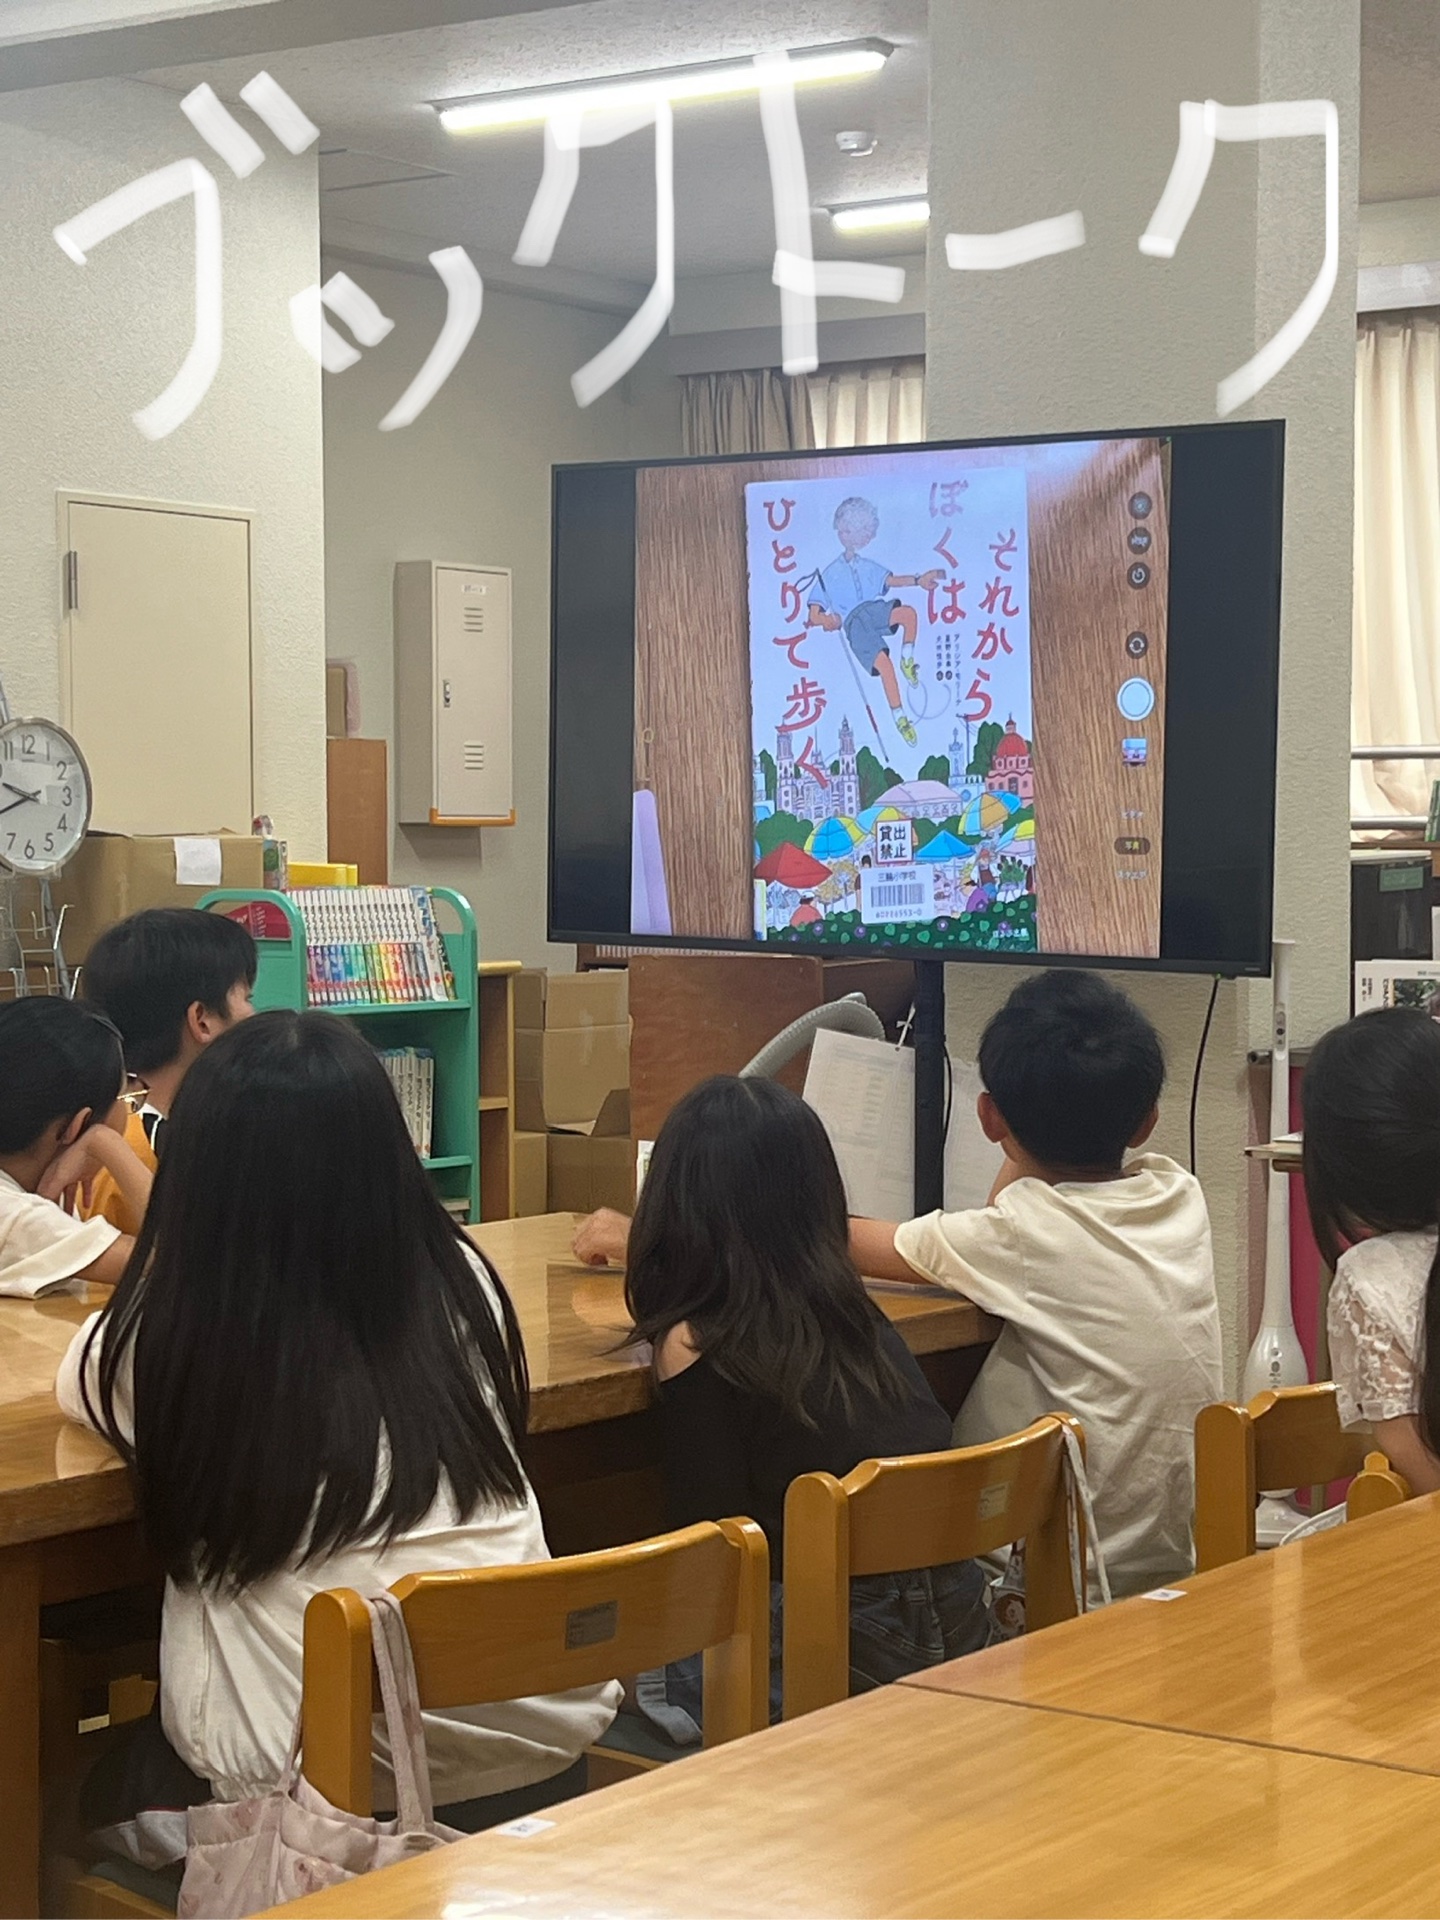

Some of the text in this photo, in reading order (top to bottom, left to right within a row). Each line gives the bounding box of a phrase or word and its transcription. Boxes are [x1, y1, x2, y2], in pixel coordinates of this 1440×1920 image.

[928, 478, 969, 626] ぼくは
[964, 528, 1020, 723] それから
[3, 740, 14, 761] 11
[21, 734, 36, 755] 12
[46, 740, 51, 762] 1
[56, 760, 68, 781] 2
[61, 785, 72, 807] 3
[56, 813, 68, 833] 4
[879, 825, 906, 842] 貸出
[5, 832, 17, 851] 7
[23, 838, 36, 860] 6
[43, 832, 54, 852] 5
[880, 842, 907, 859] 禁止
